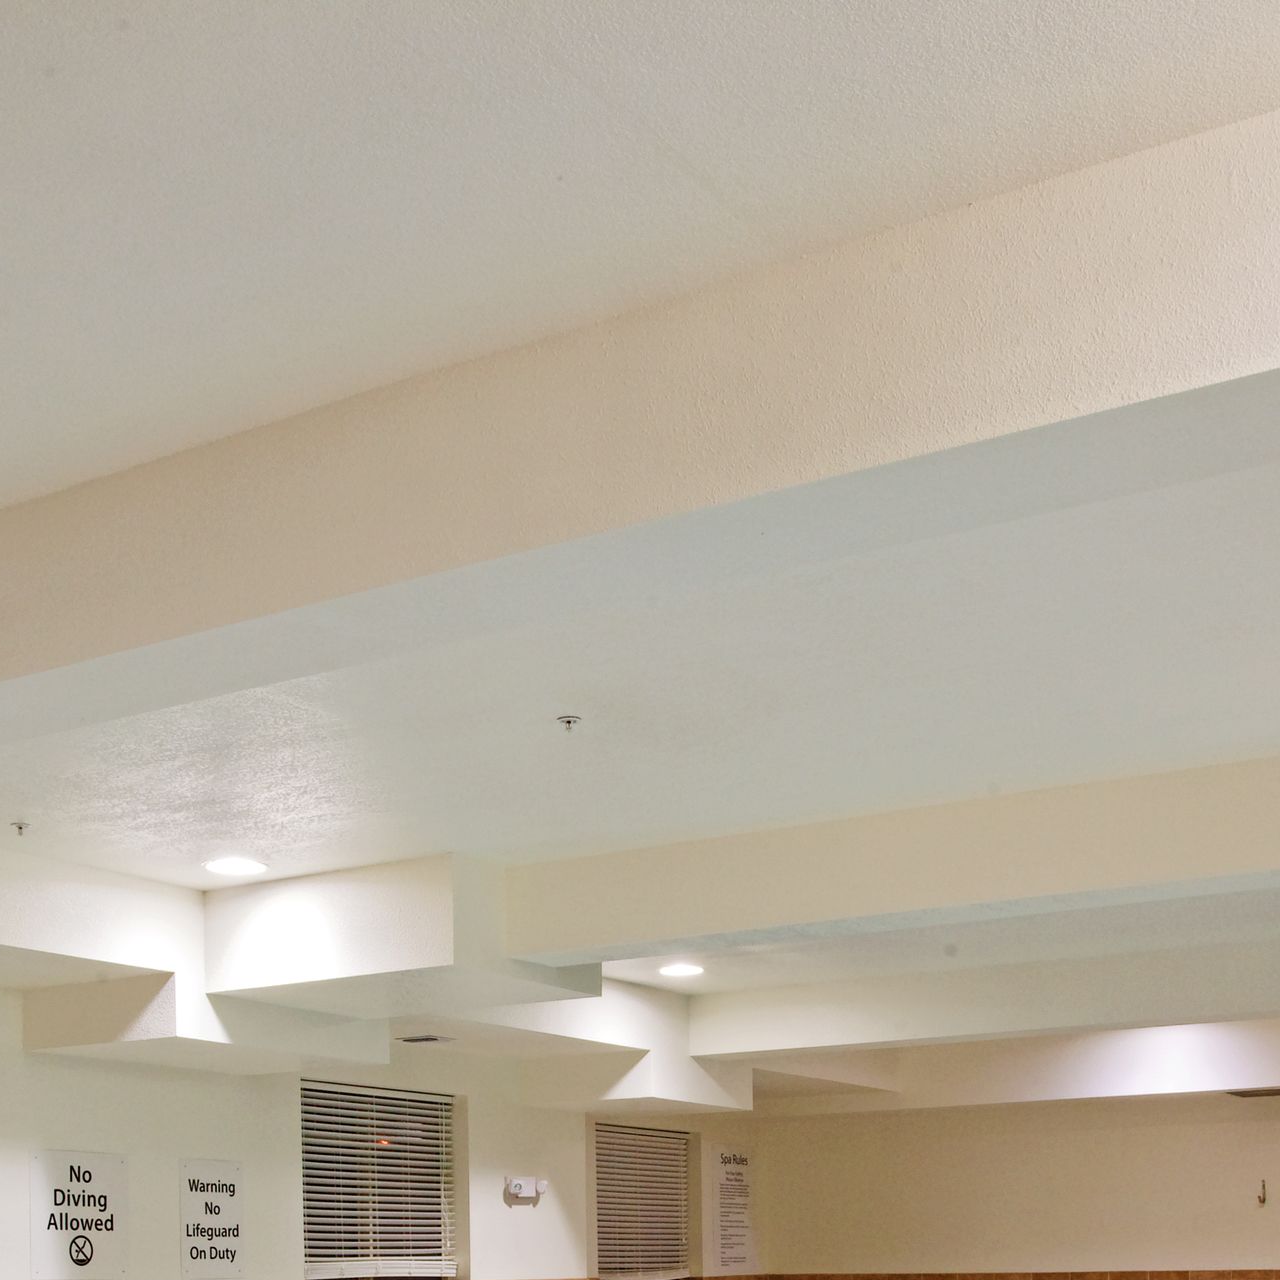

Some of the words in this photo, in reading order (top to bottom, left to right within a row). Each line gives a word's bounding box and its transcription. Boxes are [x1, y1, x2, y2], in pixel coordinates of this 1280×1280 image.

[720, 1153, 732, 1166] Spa
[733, 1154, 749, 1166] Rules
[69, 1165, 92, 1183] No
[188, 1178, 236, 1197] Warning
[53, 1188, 108, 1212] Diving
[204, 1201, 221, 1216] No
[47, 1212, 114, 1232] Allowed
[186, 1222, 239, 1240] Lifeguard
[190, 1246, 207, 1260] On
[209, 1246, 237, 1264] Duty
